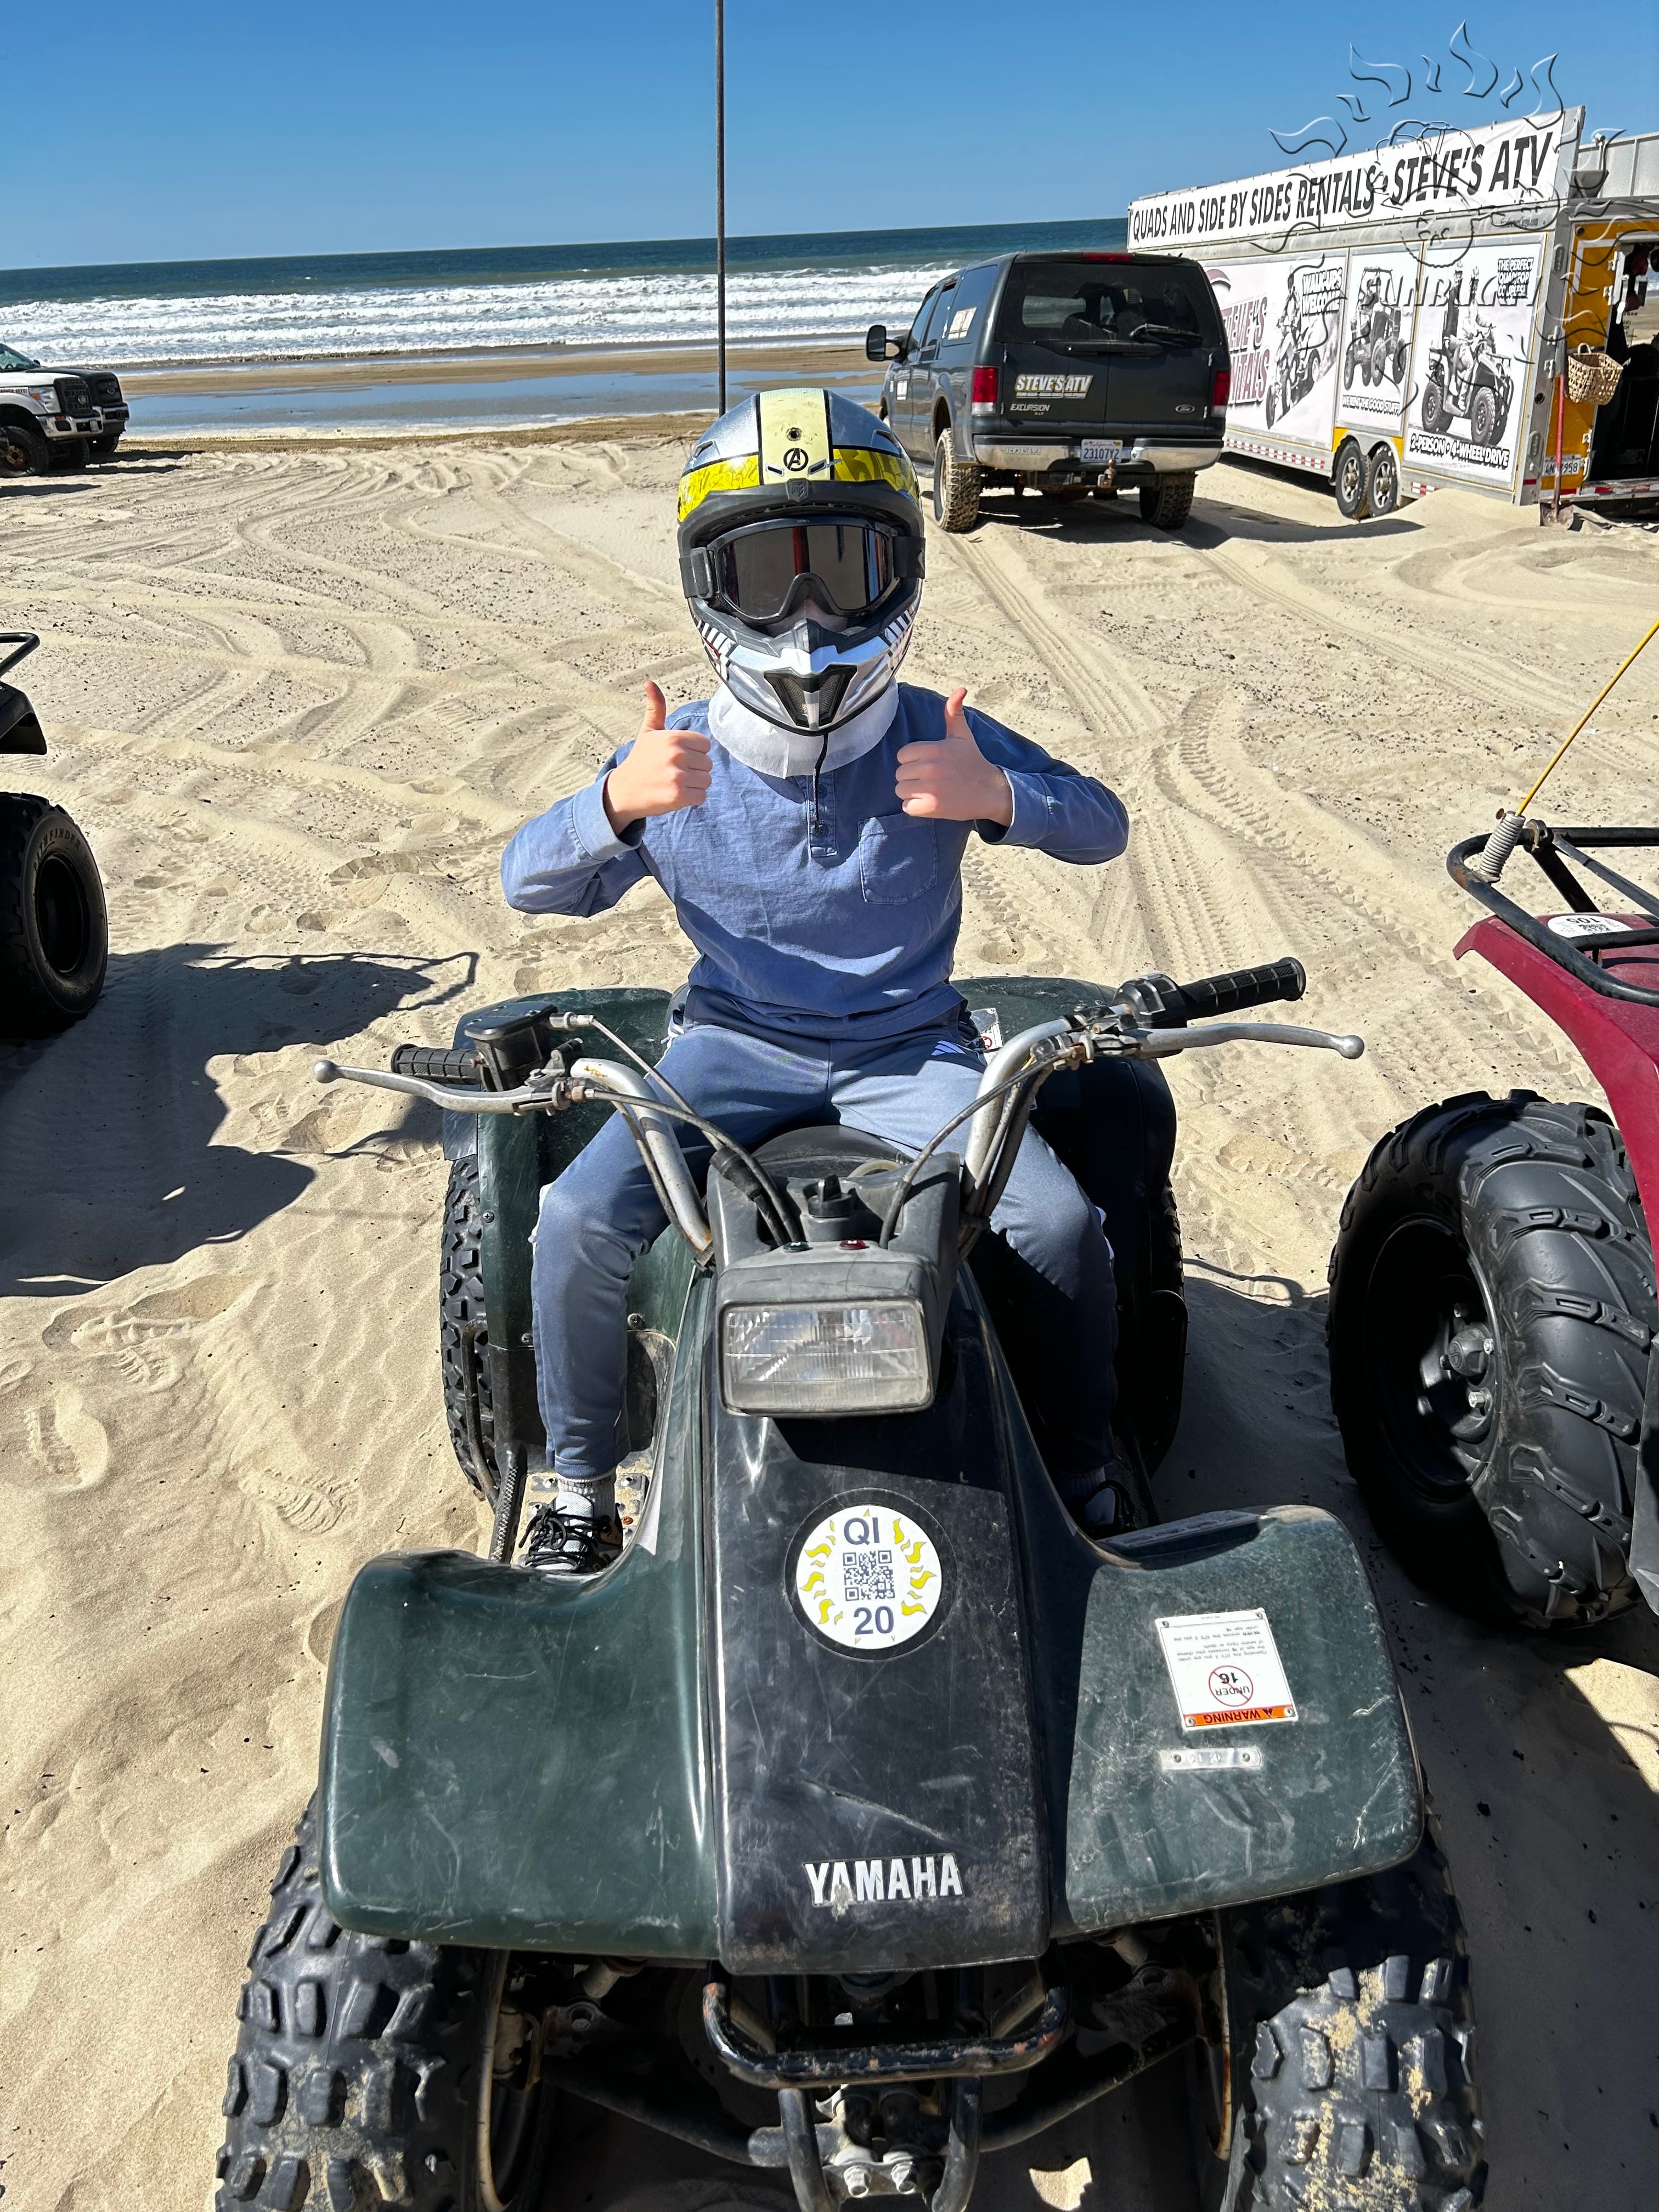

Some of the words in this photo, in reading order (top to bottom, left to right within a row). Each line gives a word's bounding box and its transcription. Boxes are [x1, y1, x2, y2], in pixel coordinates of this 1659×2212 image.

[1133, 205, 1167, 242] QUADS
[1170, 199, 1195, 235] AND
[1198, 195, 1226, 233] SIDE
[1229, 191, 1248, 228] BY
[1249, 182, 1293, 226] SIDES
[1296, 165, 1376, 218] RENTALS
[1391, 144, 1485, 205] STEVE'S
[1488, 131, 1554, 192] ATV
[1498, 258, 1510, 272] THE
[1510, 257, 1534, 272] PERFECT
[1303, 267, 1342, 295] WALK-UPS
[1302, 291, 1340, 315] WELCOME
[1016, 375, 1064, 392] STEVE'S
[1064, 375, 1092, 392] ATV
[1011, 403, 1050, 411] EXCURSION
[1369, 398, 1384, 413] GOOD
[1083, 448, 1120, 459] 23107Y2
[1410, 433, 1445, 458] 2-PERSON
[1483, 447, 1510, 470] DRIVE
[33, 828, 81, 871] PATHFINDER
[844, 1517, 880, 1545] QI
[854, 1606, 894, 1635] 20
[1218, 1672, 1239, 1684] 16
[1215, 1685, 1250, 1696] UNDER
[1203, 1708, 1261, 1724] WARNING
[805, 1855, 963, 1905] YAMAHA
